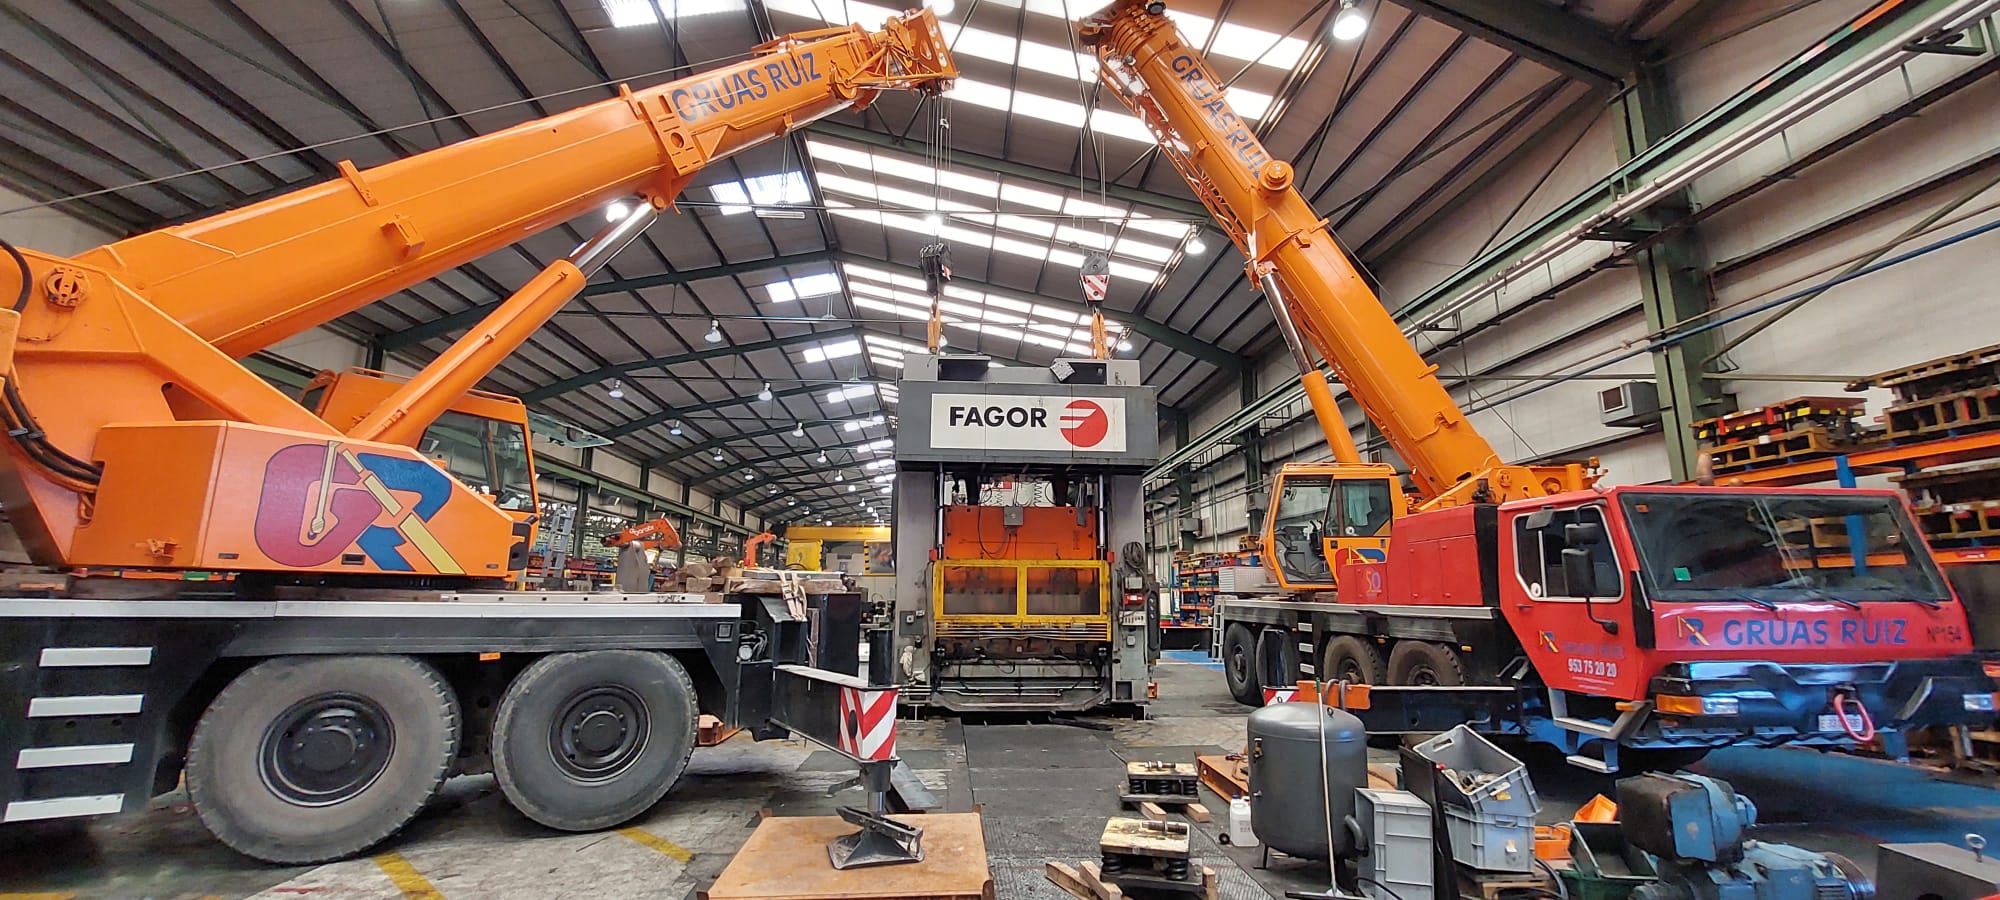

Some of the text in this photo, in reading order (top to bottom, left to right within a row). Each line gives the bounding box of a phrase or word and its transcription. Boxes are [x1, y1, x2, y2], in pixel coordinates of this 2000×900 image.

[671, 52, 822, 122] GRUAS RUIZ
[1172, 55, 1235, 129] GRUAS
[949, 406, 1047, 428] FAGOR
[1722, 619, 1829, 645] GRUAS
[1841, 619, 1908, 644] RUIZ
[1568, 658, 1617, 678] 953 75 20 20
